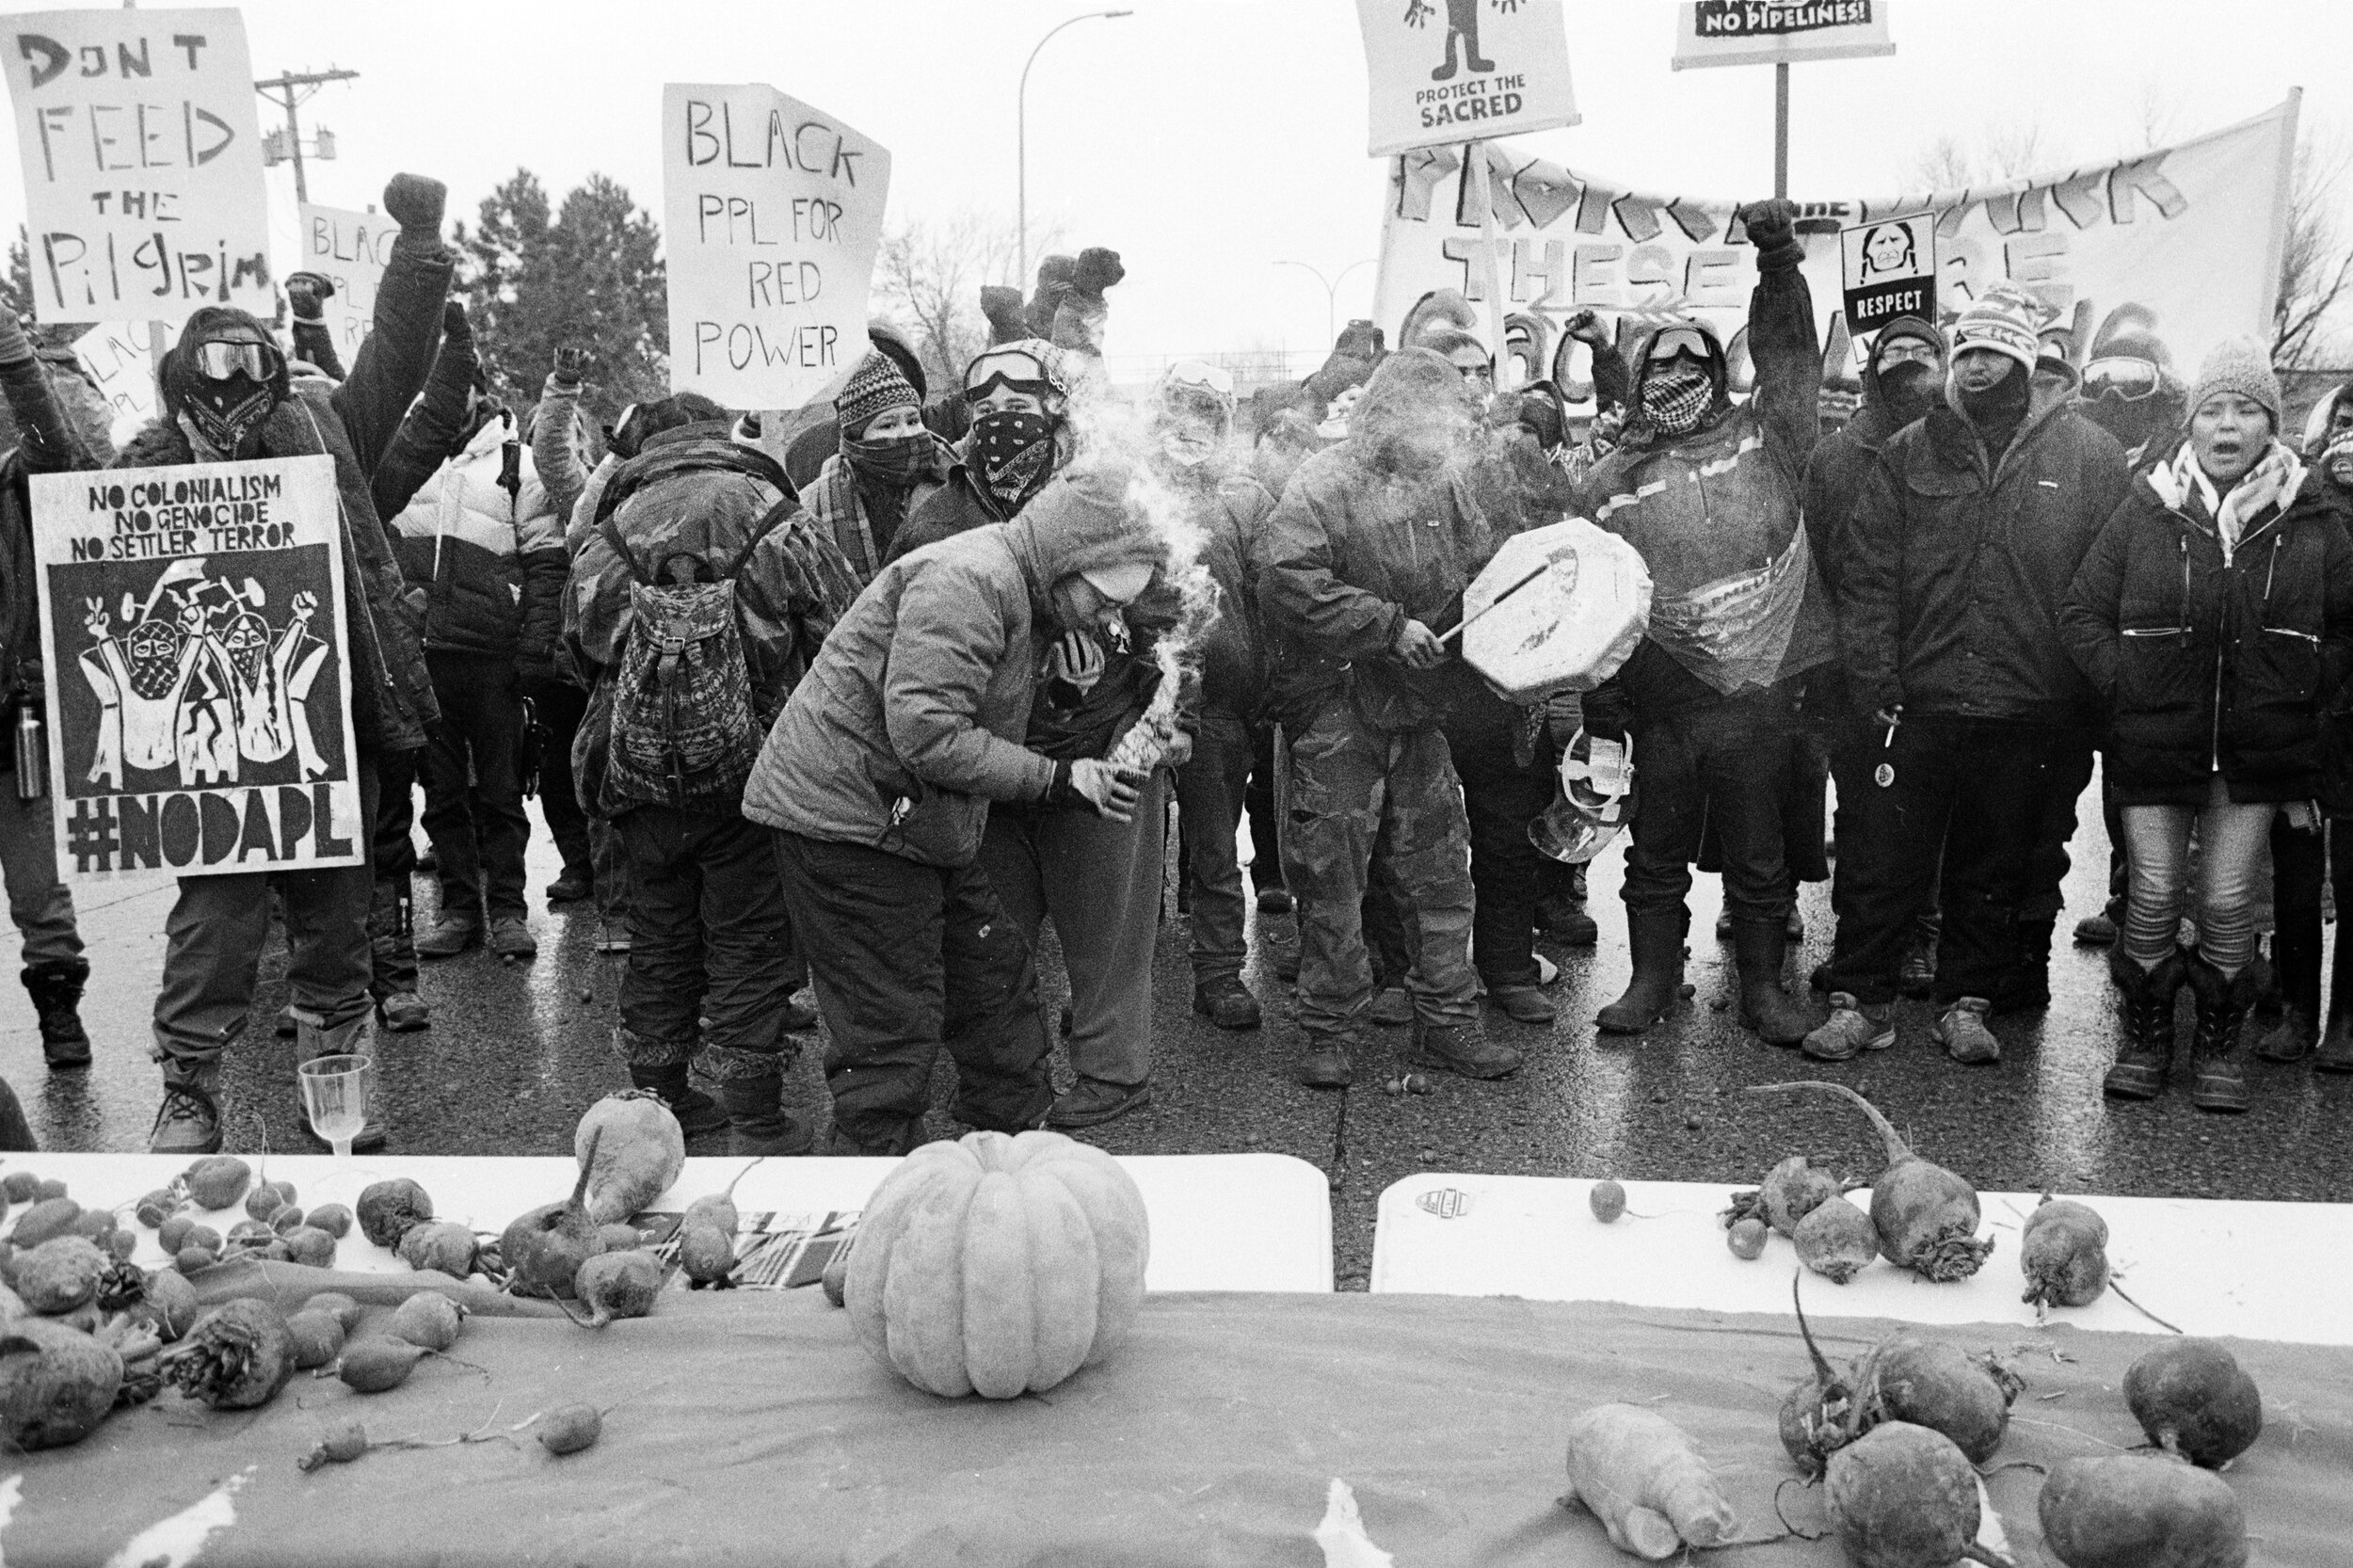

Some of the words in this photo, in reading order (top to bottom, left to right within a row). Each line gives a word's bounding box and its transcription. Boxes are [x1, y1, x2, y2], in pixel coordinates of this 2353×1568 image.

[1705, 13, 1741, 32] NO
[1746, 1, 1866, 30] PIPELINES!
[1416, 79, 1488, 105] PROTECT
[1495, 73, 1527, 91] THE
[1420, 92, 1523, 128] SACRED
[36, 100, 235, 183] FEED
[687, 100, 864, 187] BLACK
[91, 190, 183, 221] THE
[698, 194, 778, 245] PPL
[792, 198, 842, 245] FOR
[313, 216, 401, 267] BLAC
[749, 261, 822, 309] RED
[1442, 235, 1743, 309] THESE
[1857, 290, 1923, 319] RESPECT
[696, 321, 839, 376] POWER
[88, 486, 126, 512] NO
[131, 474, 281, 508] COLONIALISM
[115, 509, 152, 534] NO
[156, 501, 269, 531] GENOCIDE
[71, 536, 105, 562] NO
[110, 529, 198, 559] SETTLER
[209, 521, 296, 552] TERROR
[66, 783, 355, 874] #NODAPL
